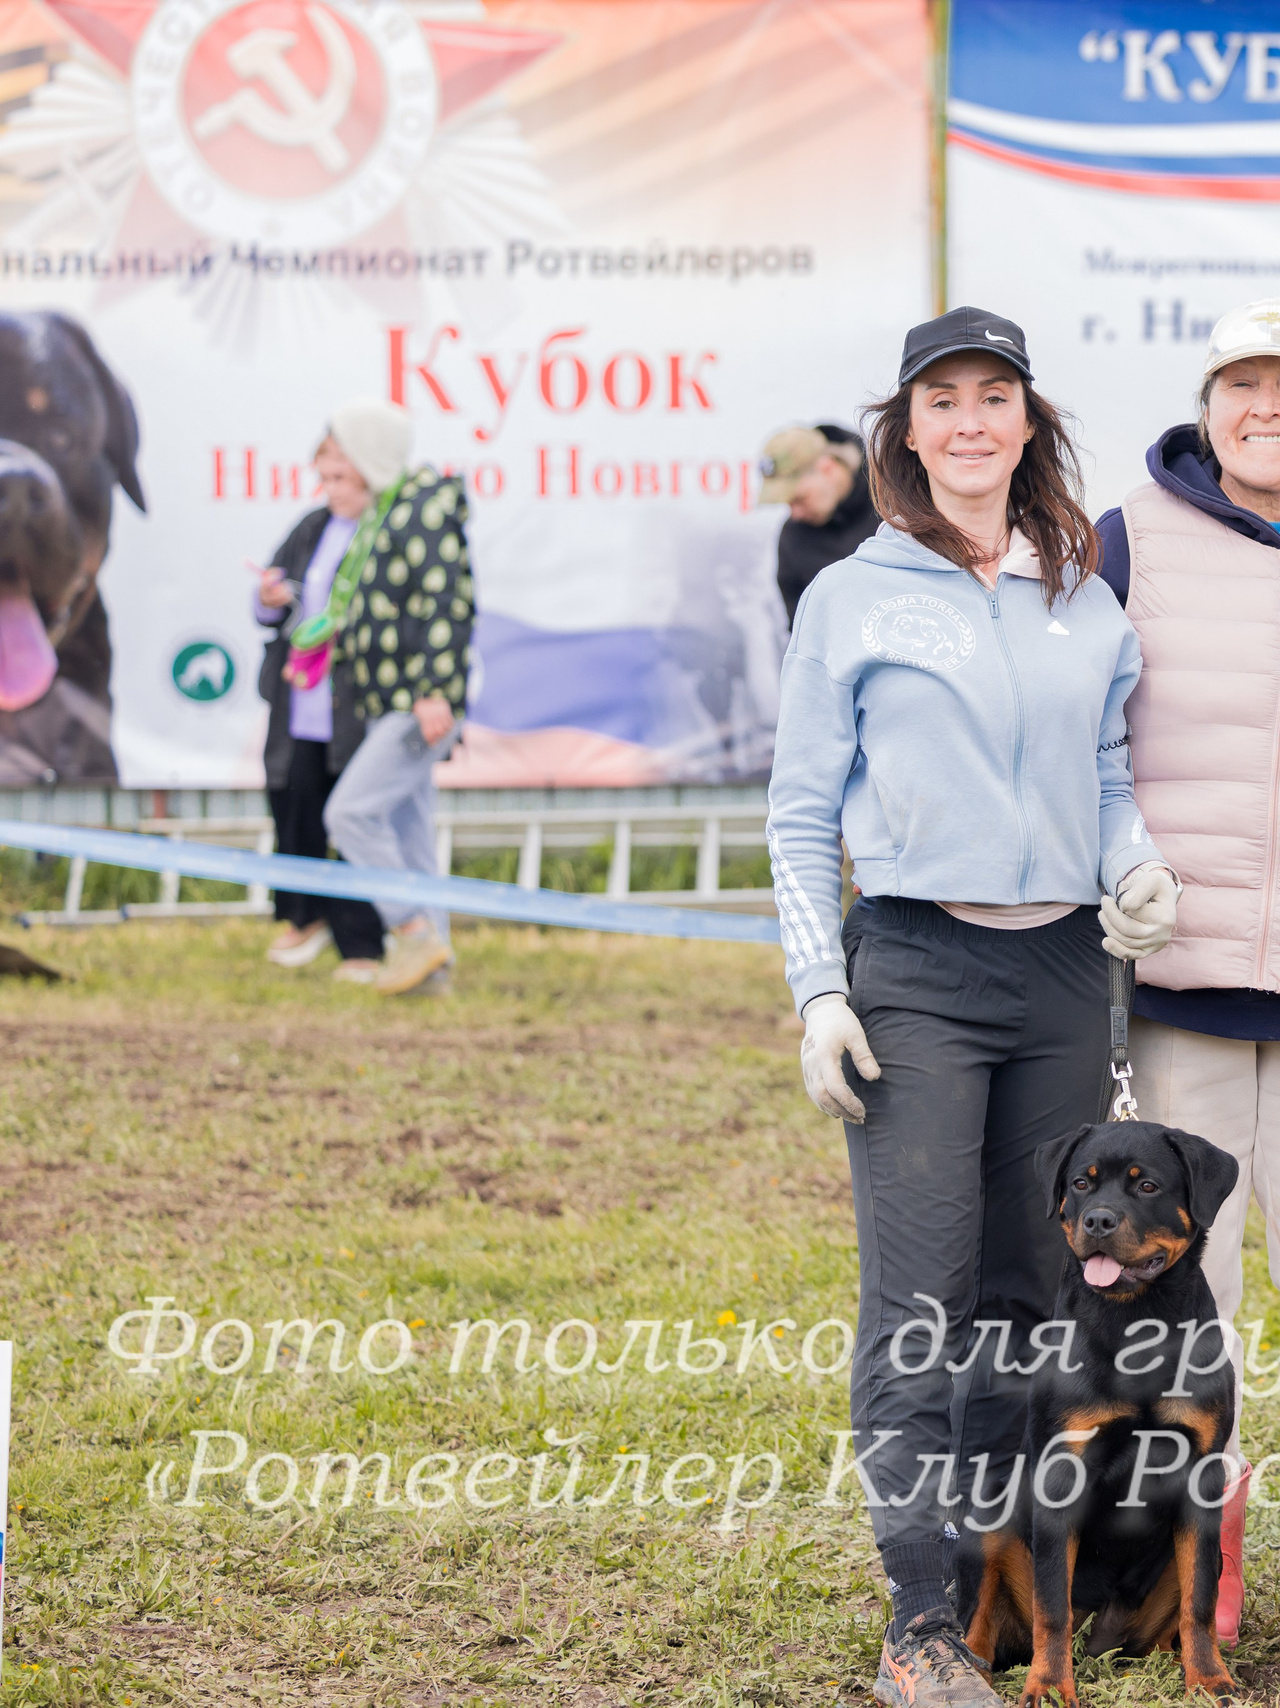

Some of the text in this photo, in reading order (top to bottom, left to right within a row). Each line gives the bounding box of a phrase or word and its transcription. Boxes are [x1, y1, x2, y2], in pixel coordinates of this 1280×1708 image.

[231, 243, 490, 280] Чемпионат
[506, 238, 816, 286] Ротвейлеров
[385, 323, 720, 442] Кубок
[870, 597, 961, 623] IZ DOMA TORRA
[886, 651, 960, 670] ROTTWEER
